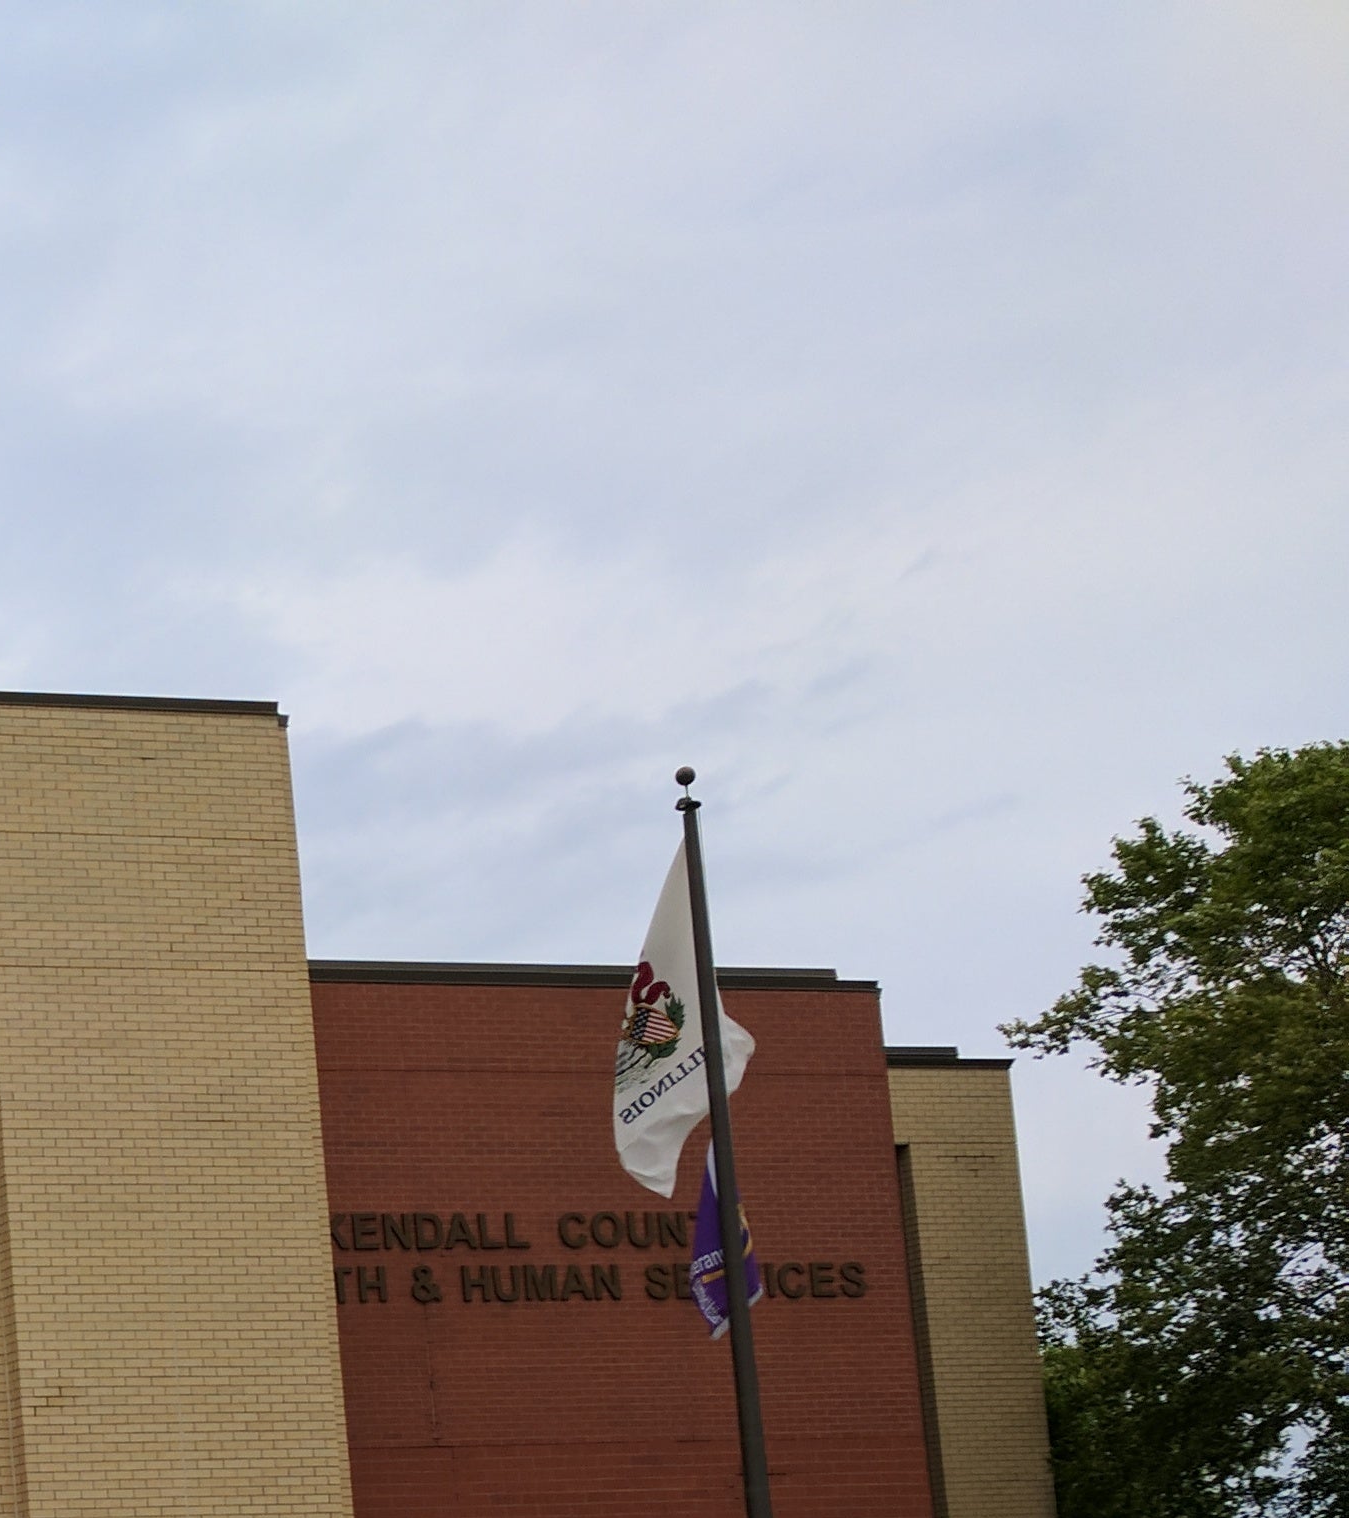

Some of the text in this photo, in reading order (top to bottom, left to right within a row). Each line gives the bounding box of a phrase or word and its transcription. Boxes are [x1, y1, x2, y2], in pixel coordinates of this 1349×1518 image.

[330, 1211, 698, 1250] KENDALL COUN
[412, 1264, 442, 1304] &
[460, 1264, 621, 1303] HUMAN
[645, 1261, 868, 1300] SEICES
